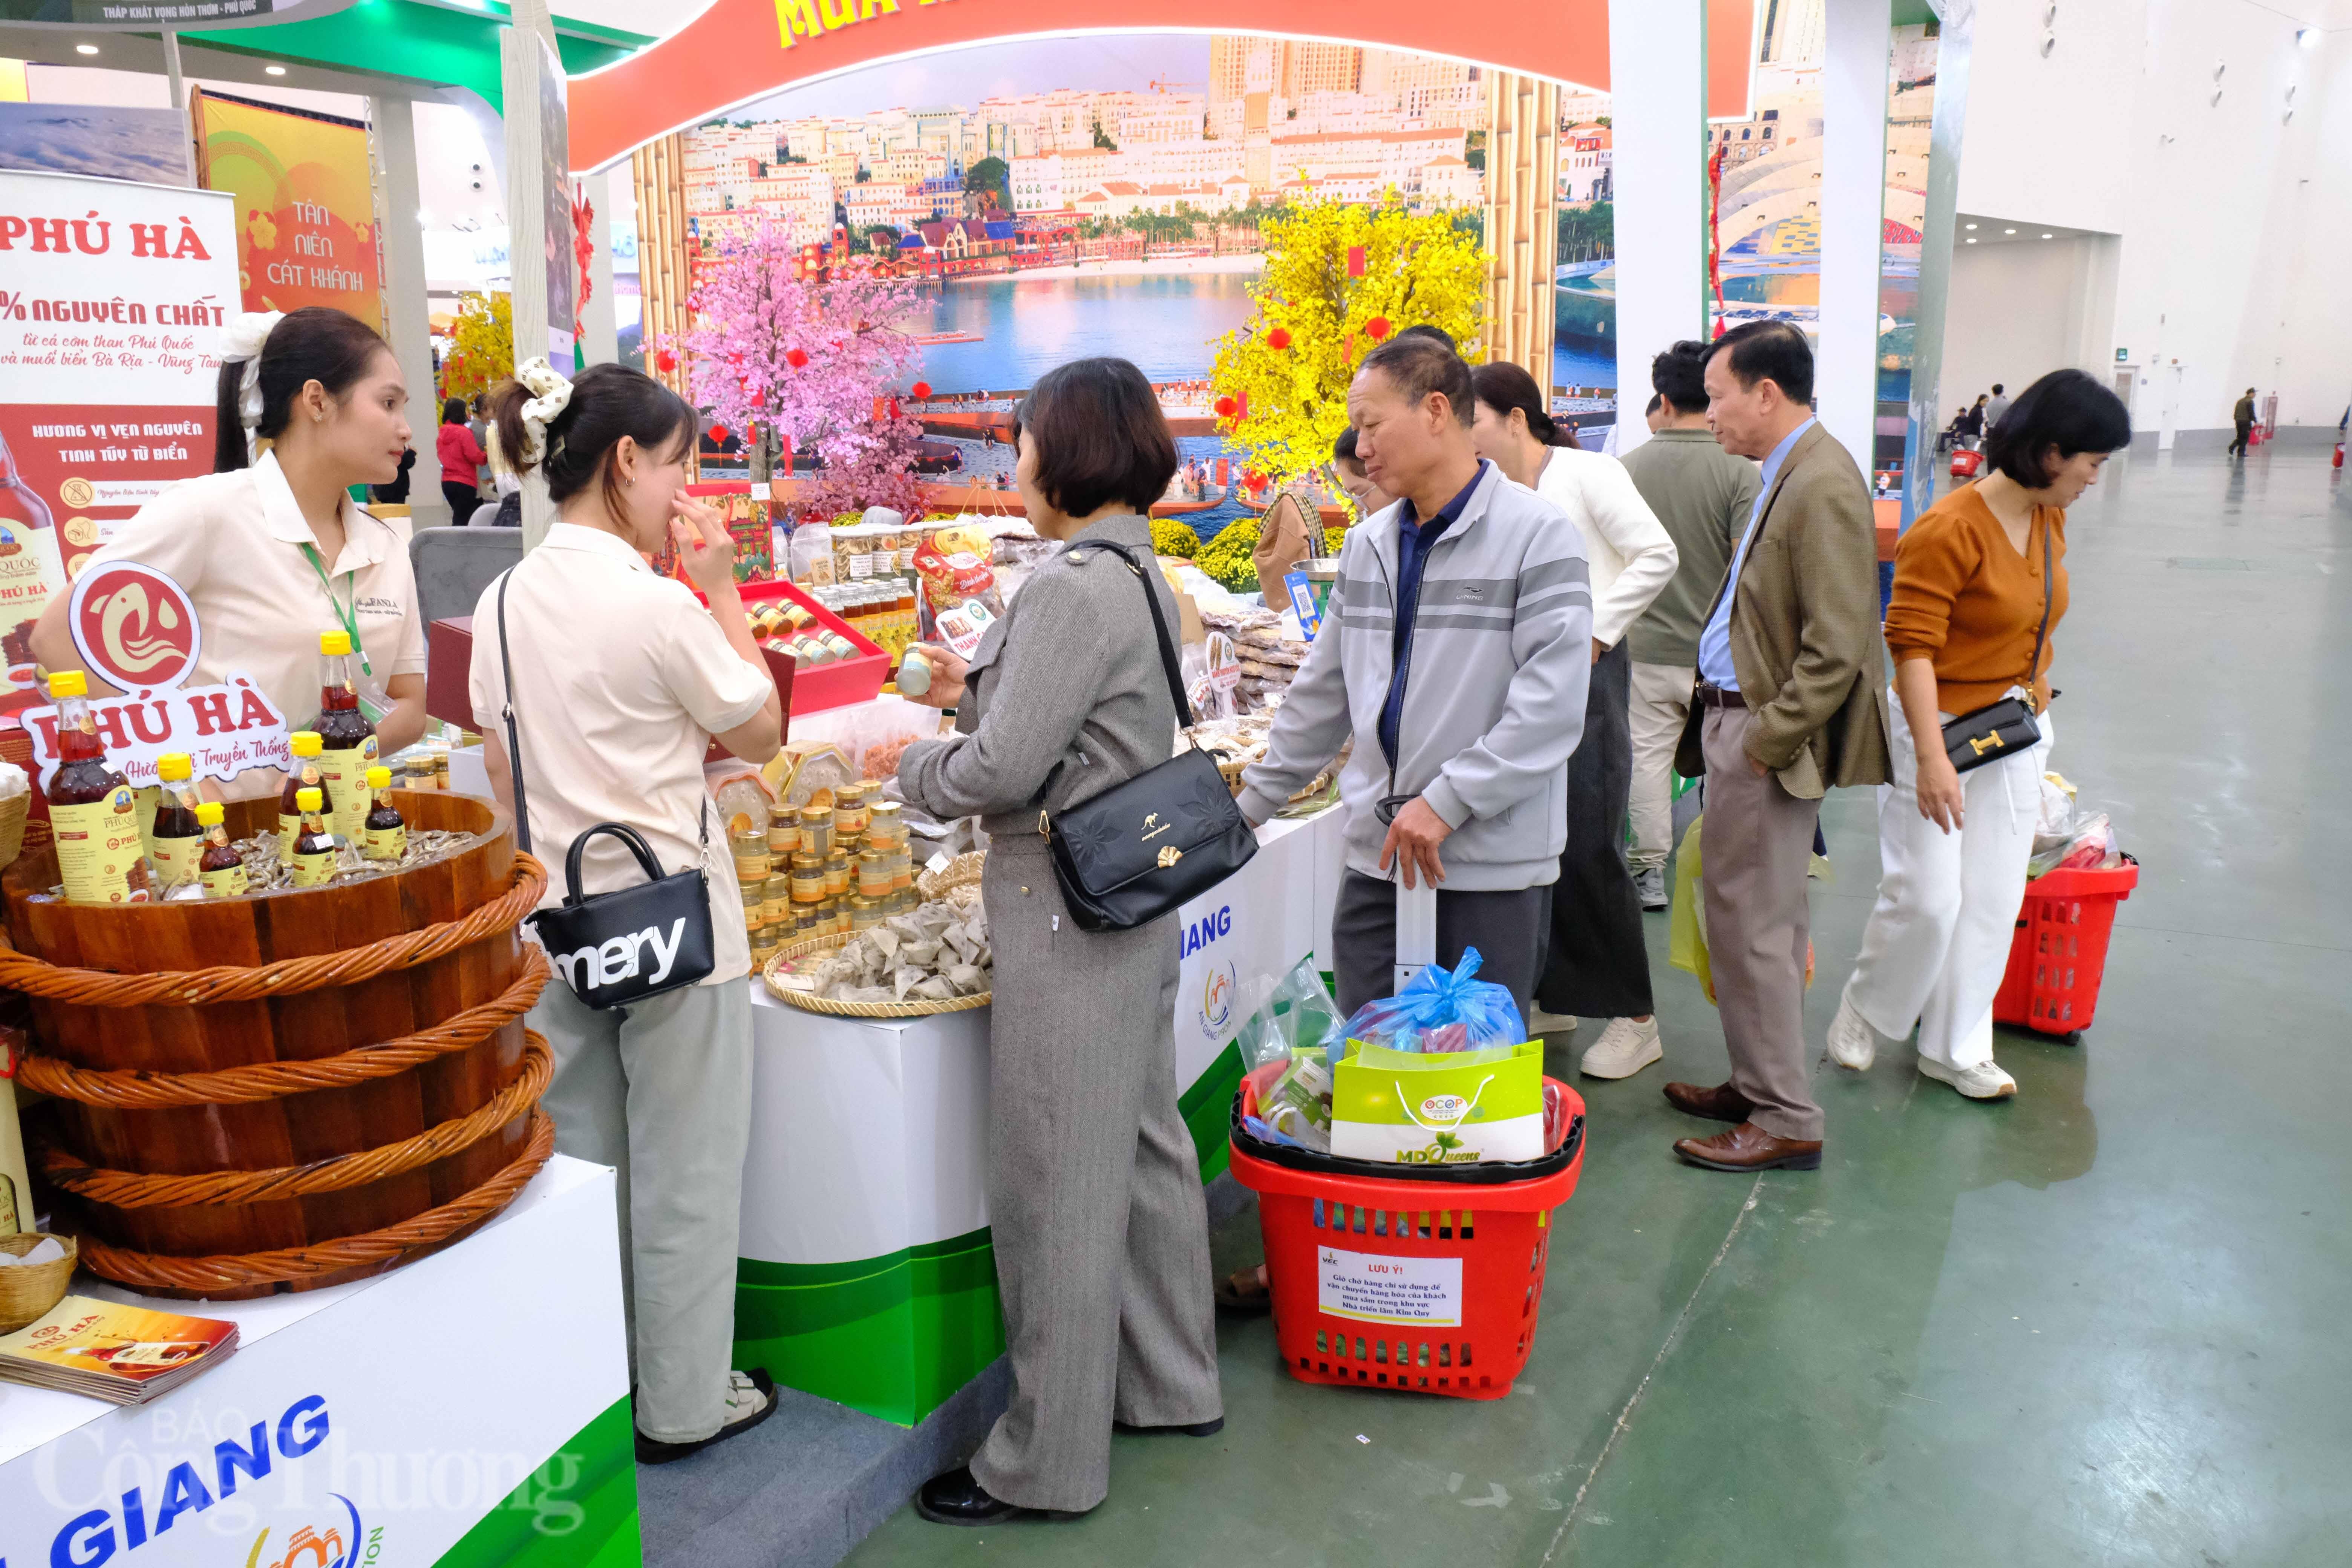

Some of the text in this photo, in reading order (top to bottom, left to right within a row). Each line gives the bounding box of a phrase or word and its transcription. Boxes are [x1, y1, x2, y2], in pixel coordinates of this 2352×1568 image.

[292, 199, 329, 226] TÂN
[0, 210, 211, 260] PHÚ HÀ
[294, 234, 333, 257] NIÊN
[267, 262, 364, 292] CÁT KHÁNH
[32, 296, 147, 324] NGUYÊN
[156, 294, 225, 327] CHẤT
[42, 333, 58, 347] cá
[93, 335, 124, 348] than
[129, 334, 157, 349] Phú
[161, 335, 194, 352] Quốc
[0, 351, 18, 364] và
[61, 348, 88, 366] biển
[92, 352, 114, 367] Bà
[118, 352, 143, 370] Rịa
[158, 353, 194, 375] Vũng
[90, 424, 108, 439] VỊ
[110, 424, 139, 439] VẸN
[143, 420, 202, 436] NGUYÊN
[58, 449, 96, 462] TINH
[99, 446, 127, 462] TÚY
[153, 441, 188, 461] BIỂN
[0, 582, 48, 599] HÚ HÀ
[188, 678, 279, 736] HÀ
[198, 743, 248, 772] Truyền
[250, 736, 290, 761] Thống
[1180, 905, 1231, 960] IANG
[1203, 1024, 1217, 1040] GIANG
[1425, 1098, 1463, 1109] OCOP
[1322, 1257, 1338, 1265] VEC
[1369, 1264, 1403, 1274] LƯU Ý!
[1364, 1279, 1383, 1288] hàng
[1409, 1283, 1429, 1291] dụng
[1370, 1288, 1389, 1297] hàng
[1391, 1289, 1405, 1298] hóa
[1343, 1301, 1358, 1310] Nhà
[50, 1394, 329, 1568] GIANG
